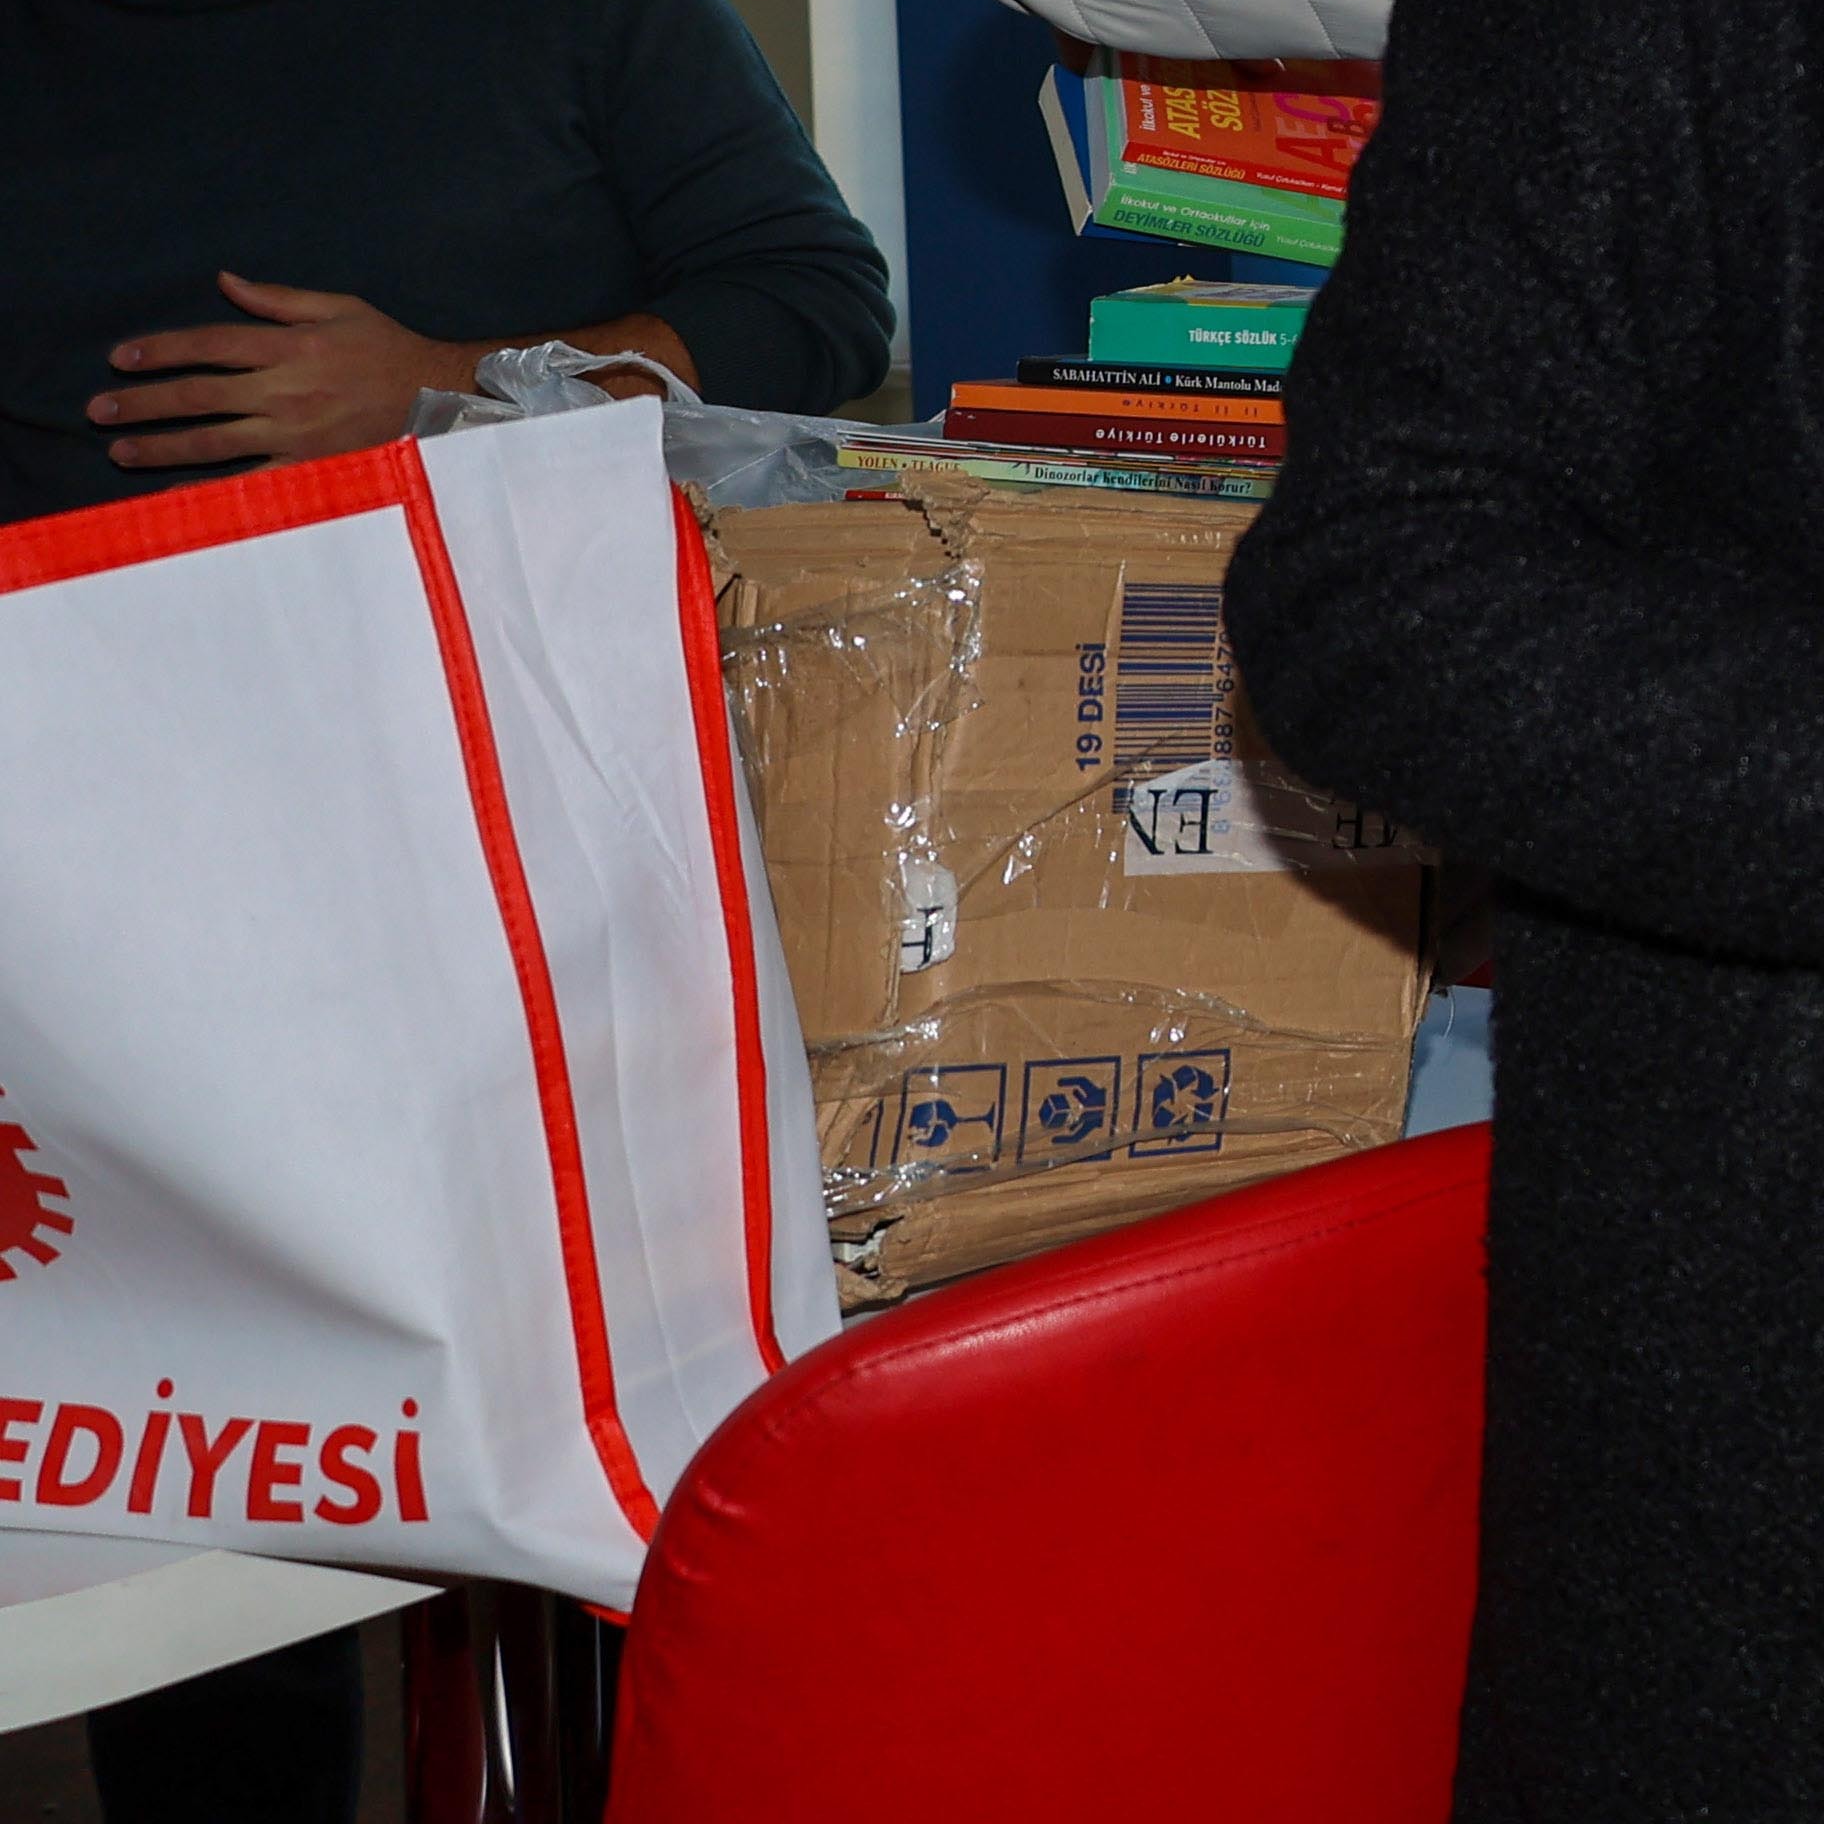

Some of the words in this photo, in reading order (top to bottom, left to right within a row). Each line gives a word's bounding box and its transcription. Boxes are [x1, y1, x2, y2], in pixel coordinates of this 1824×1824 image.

[1162, 85, 1201, 140] ATAS
[1202, 88, 1244, 133] SÖZ
[1112, 207, 1191, 235] DEYİMLER
[1162, 203, 1177, 213] ve
[1188, 328, 1231, 347] TÜRKÇE
[1235, 330, 1277, 346] SÖZLÜK
[1052, 367, 1136, 386] SABAHATTİN
[1139, 370, 1161, 386] ALİ
[1175, 375, 1203, 389] Kürk
[1205, 378, 1251, 392] Mantolu
[1254, 379, 1283, 393] Mad
[1096, 428, 1163, 445] Türkiye
[1170, 432, 1266, 449] Türkülerle
[1034, 466, 1101, 485] Dinozorlar
[1075, 642, 1106, 723] DESİ
[1075, 732, 1103, 772] 19
[0, 1378, 429, 1526] EDİYESİ
